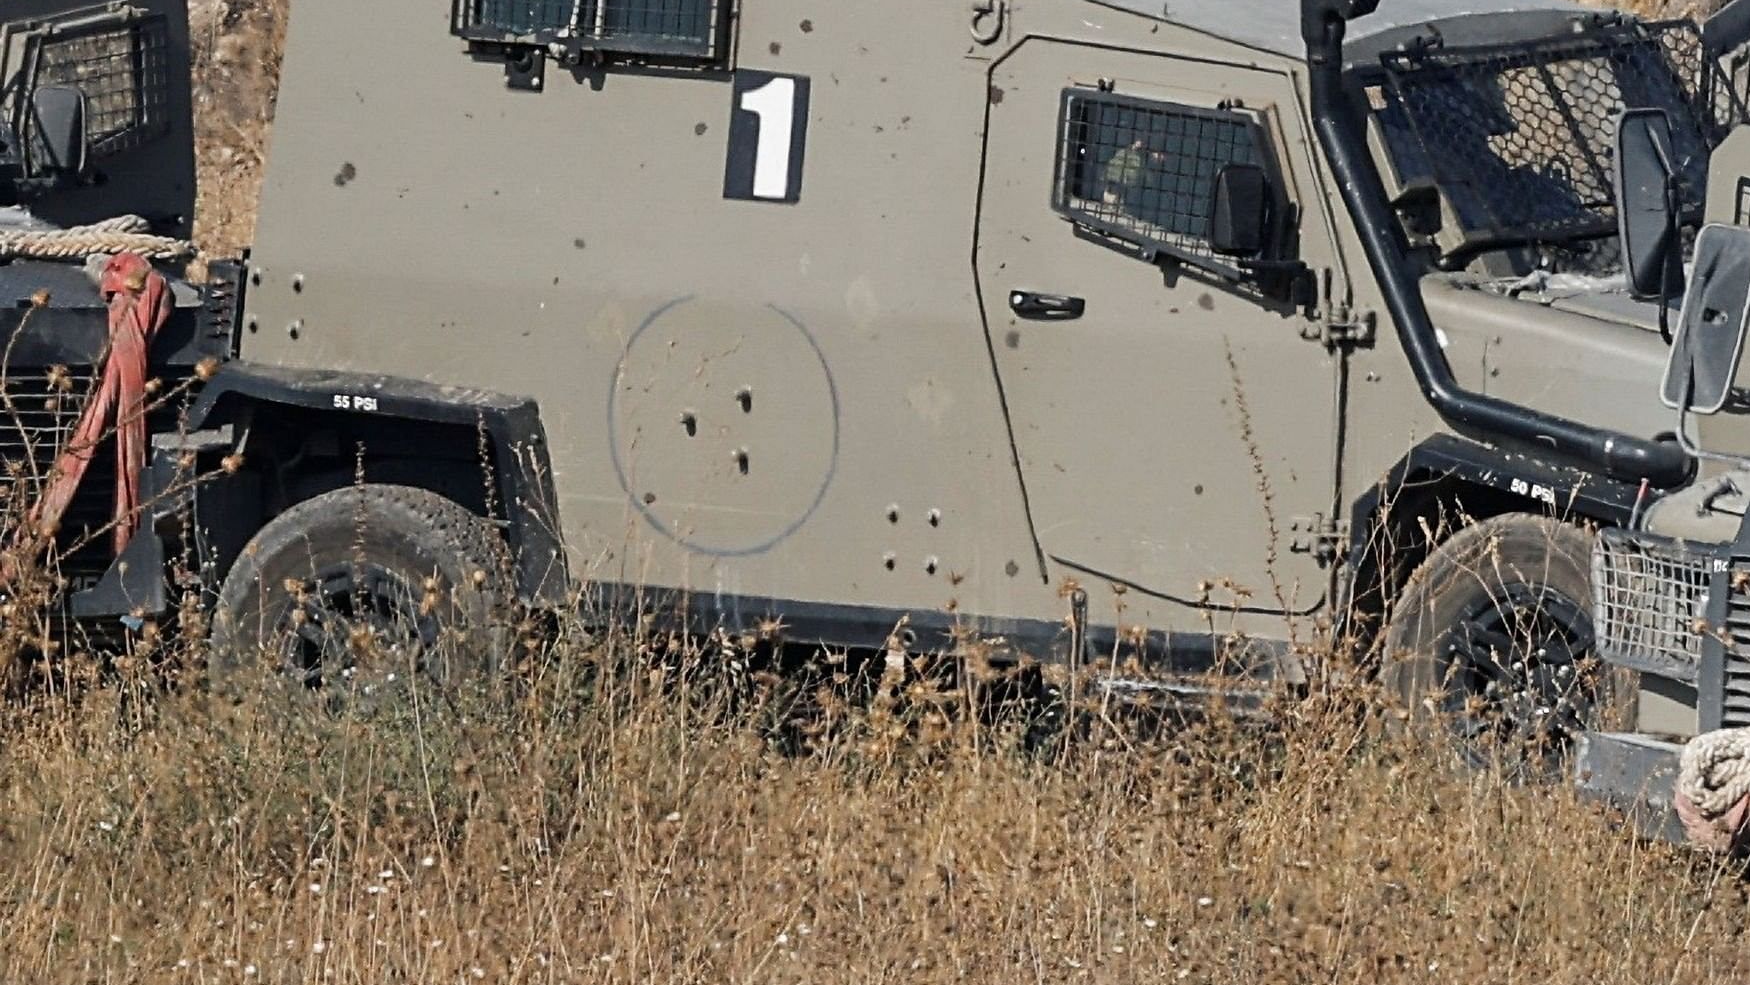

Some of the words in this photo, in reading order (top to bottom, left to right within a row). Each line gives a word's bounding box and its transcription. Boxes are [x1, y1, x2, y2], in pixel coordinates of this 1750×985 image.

[741, 77, 795, 199] 1
[334, 395, 350, 408] 55
[354, 396, 377, 411] PSI
[1511, 478, 1528, 495] 50
